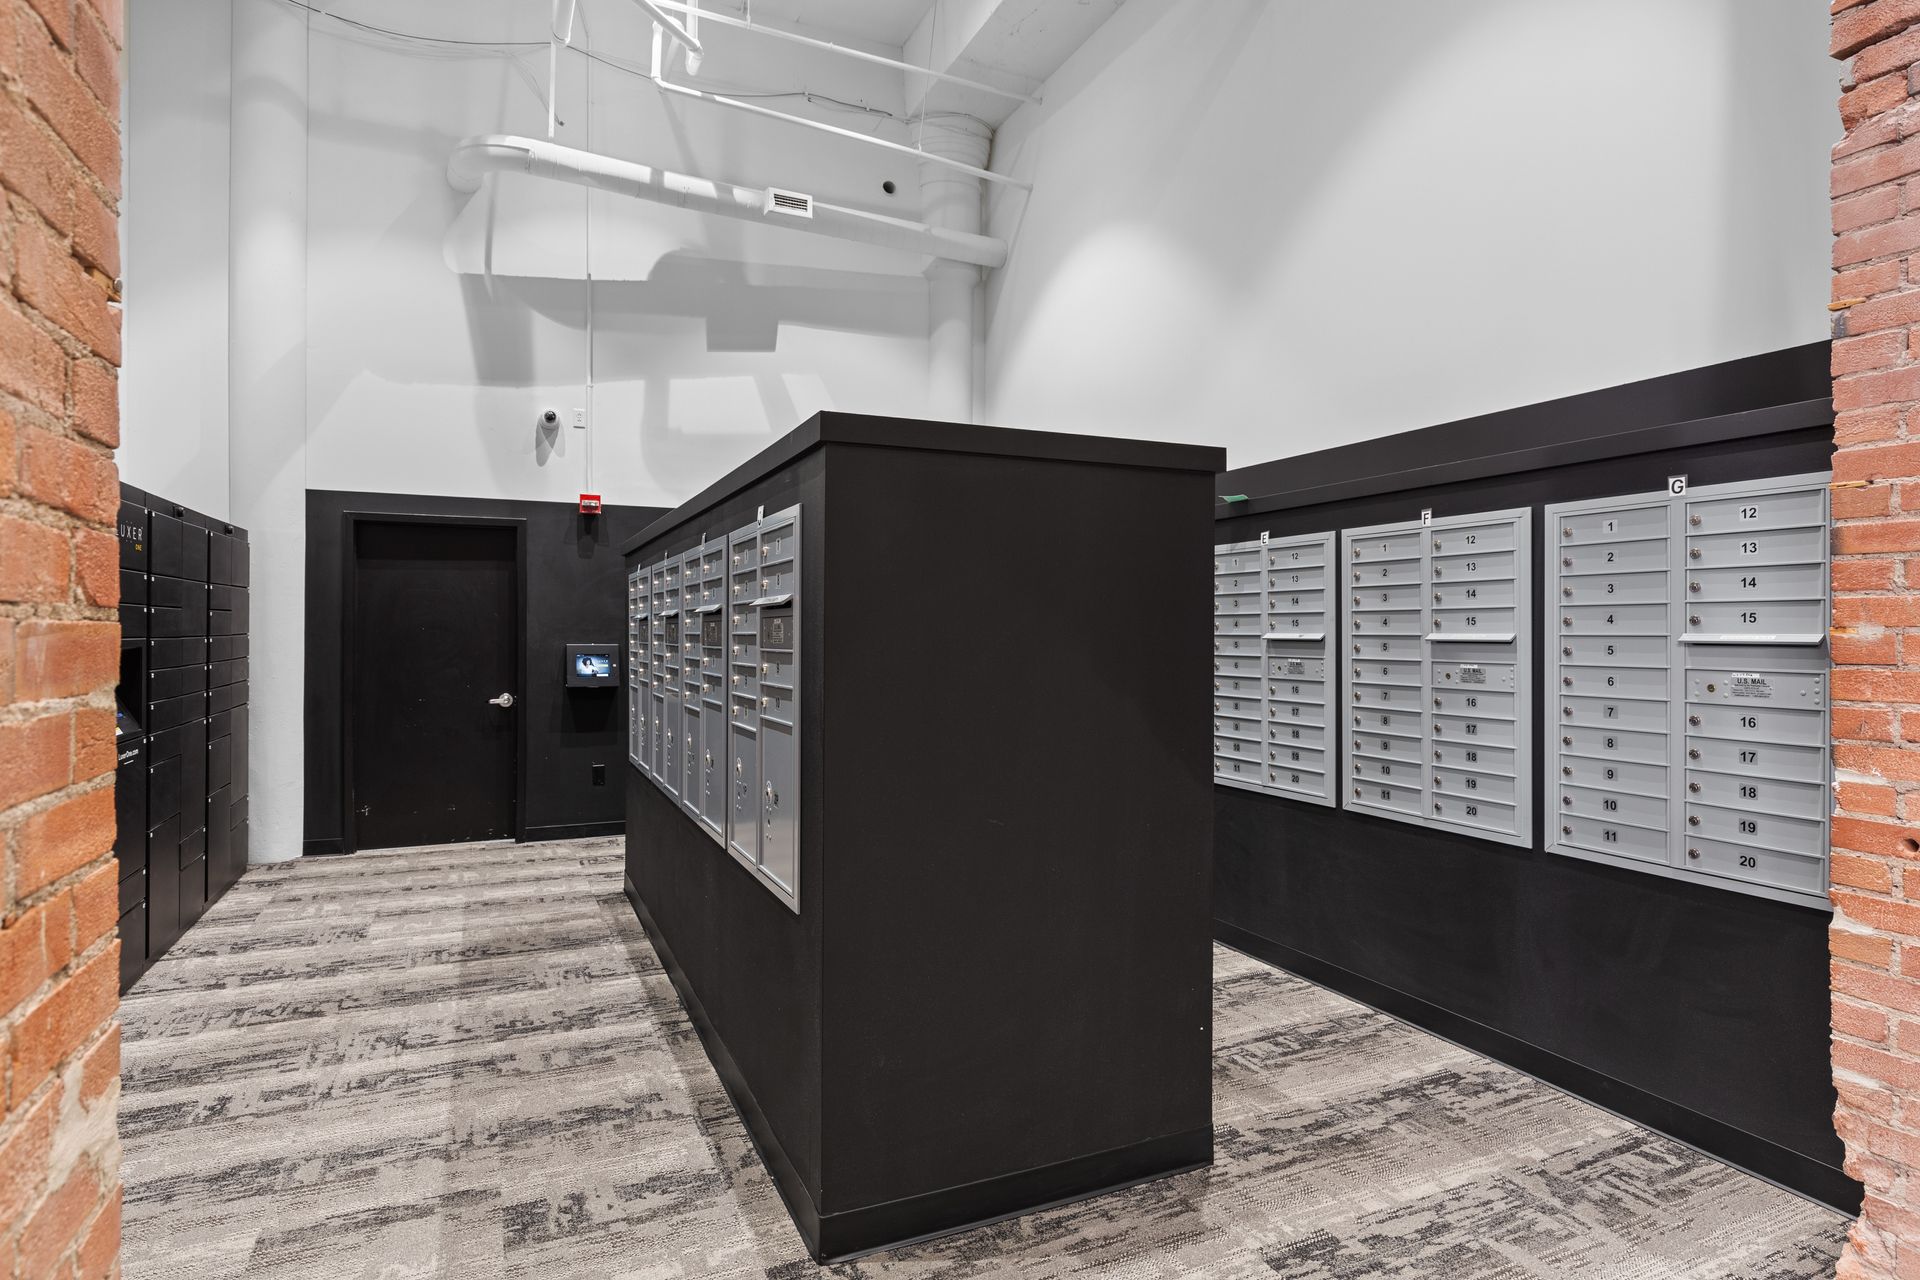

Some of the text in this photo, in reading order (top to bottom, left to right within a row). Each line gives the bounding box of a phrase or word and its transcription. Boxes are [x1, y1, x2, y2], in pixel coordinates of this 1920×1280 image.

[1671, 480, 1684, 494] G
[1741, 507, 1756, 519] 12
[1424, 513, 1430, 525] F
[1608, 522, 1613, 531] 1
[115, 524, 143, 541] UXER
[1466, 535, 1476, 544] 12
[1383, 544, 1386, 552] 1
[1742, 542, 1757, 553] 13
[1607, 552, 1614, 562] 2
[1466, 562, 1476, 571] 13
[1383, 568, 1387, 577] 2
[1741, 577, 1757, 588] 14
[1608, 583, 1614, 593] 3
[1383, 593, 1387, 602] 3
[1466, 589, 1476, 598] 14
[1383, 618, 1388, 626] 4
[1466, 617, 1476, 626] 15
[1607, 614, 1614, 624] 4
[1741, 612, 1757, 623] 15
[1383, 643, 1388, 651] 5
[1608, 645, 1614, 655] 5
[1383, 667, 1388, 675] 6
[1607, 676, 1614, 686] 6
[1383, 692, 1388, 700] 7
[1466, 698, 1476, 707] 16
[1607, 707, 1614, 717] 7
[1383, 716, 1388, 725] 8
[1740, 717, 1756, 728] 16
[1466, 724, 1477, 734] 17
[1383, 742, 1388, 750] 9
[1607, 738, 1614, 748] 8
[1466, 752, 1477, 762] 18
[1740, 751, 1756, 763] 17
[1381, 765, 1390, 775] 10
[1607, 769, 1614, 779] 9
[1466, 779, 1476, 789] 19
[1381, 790, 1390, 800] 11
[1741, 786, 1756, 798] 18
[1604, 800, 1617, 811] 10
[1466, 806, 1477, 816] 20
[1740, 821, 1756, 833] 19
[1604, 831, 1616, 842] 11
[1740, 855, 1756, 868] 20
